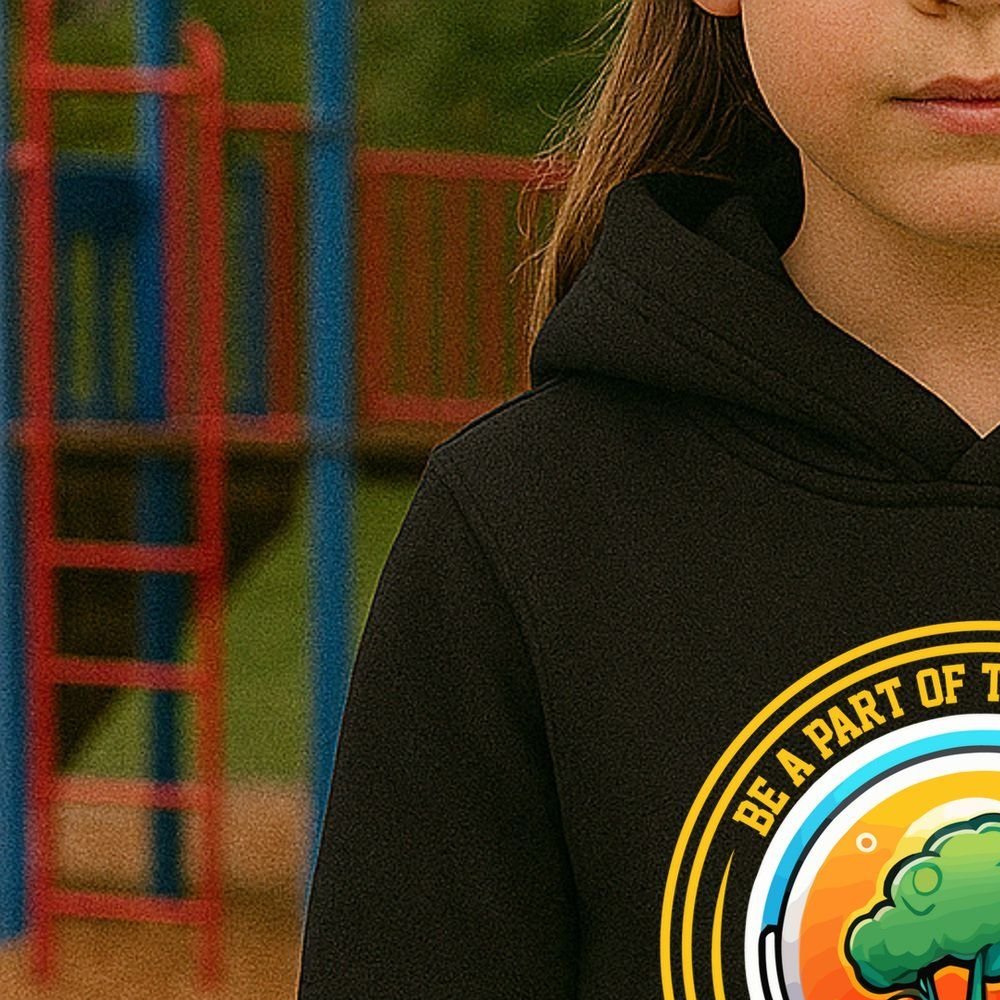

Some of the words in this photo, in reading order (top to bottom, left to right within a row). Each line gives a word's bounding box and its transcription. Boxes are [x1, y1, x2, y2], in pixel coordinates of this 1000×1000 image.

[732, 776, 790, 838] BE
[776, 748, 816, 788] A
[801, 676, 905, 761] PART
[915, 662, 966, 709] OF
